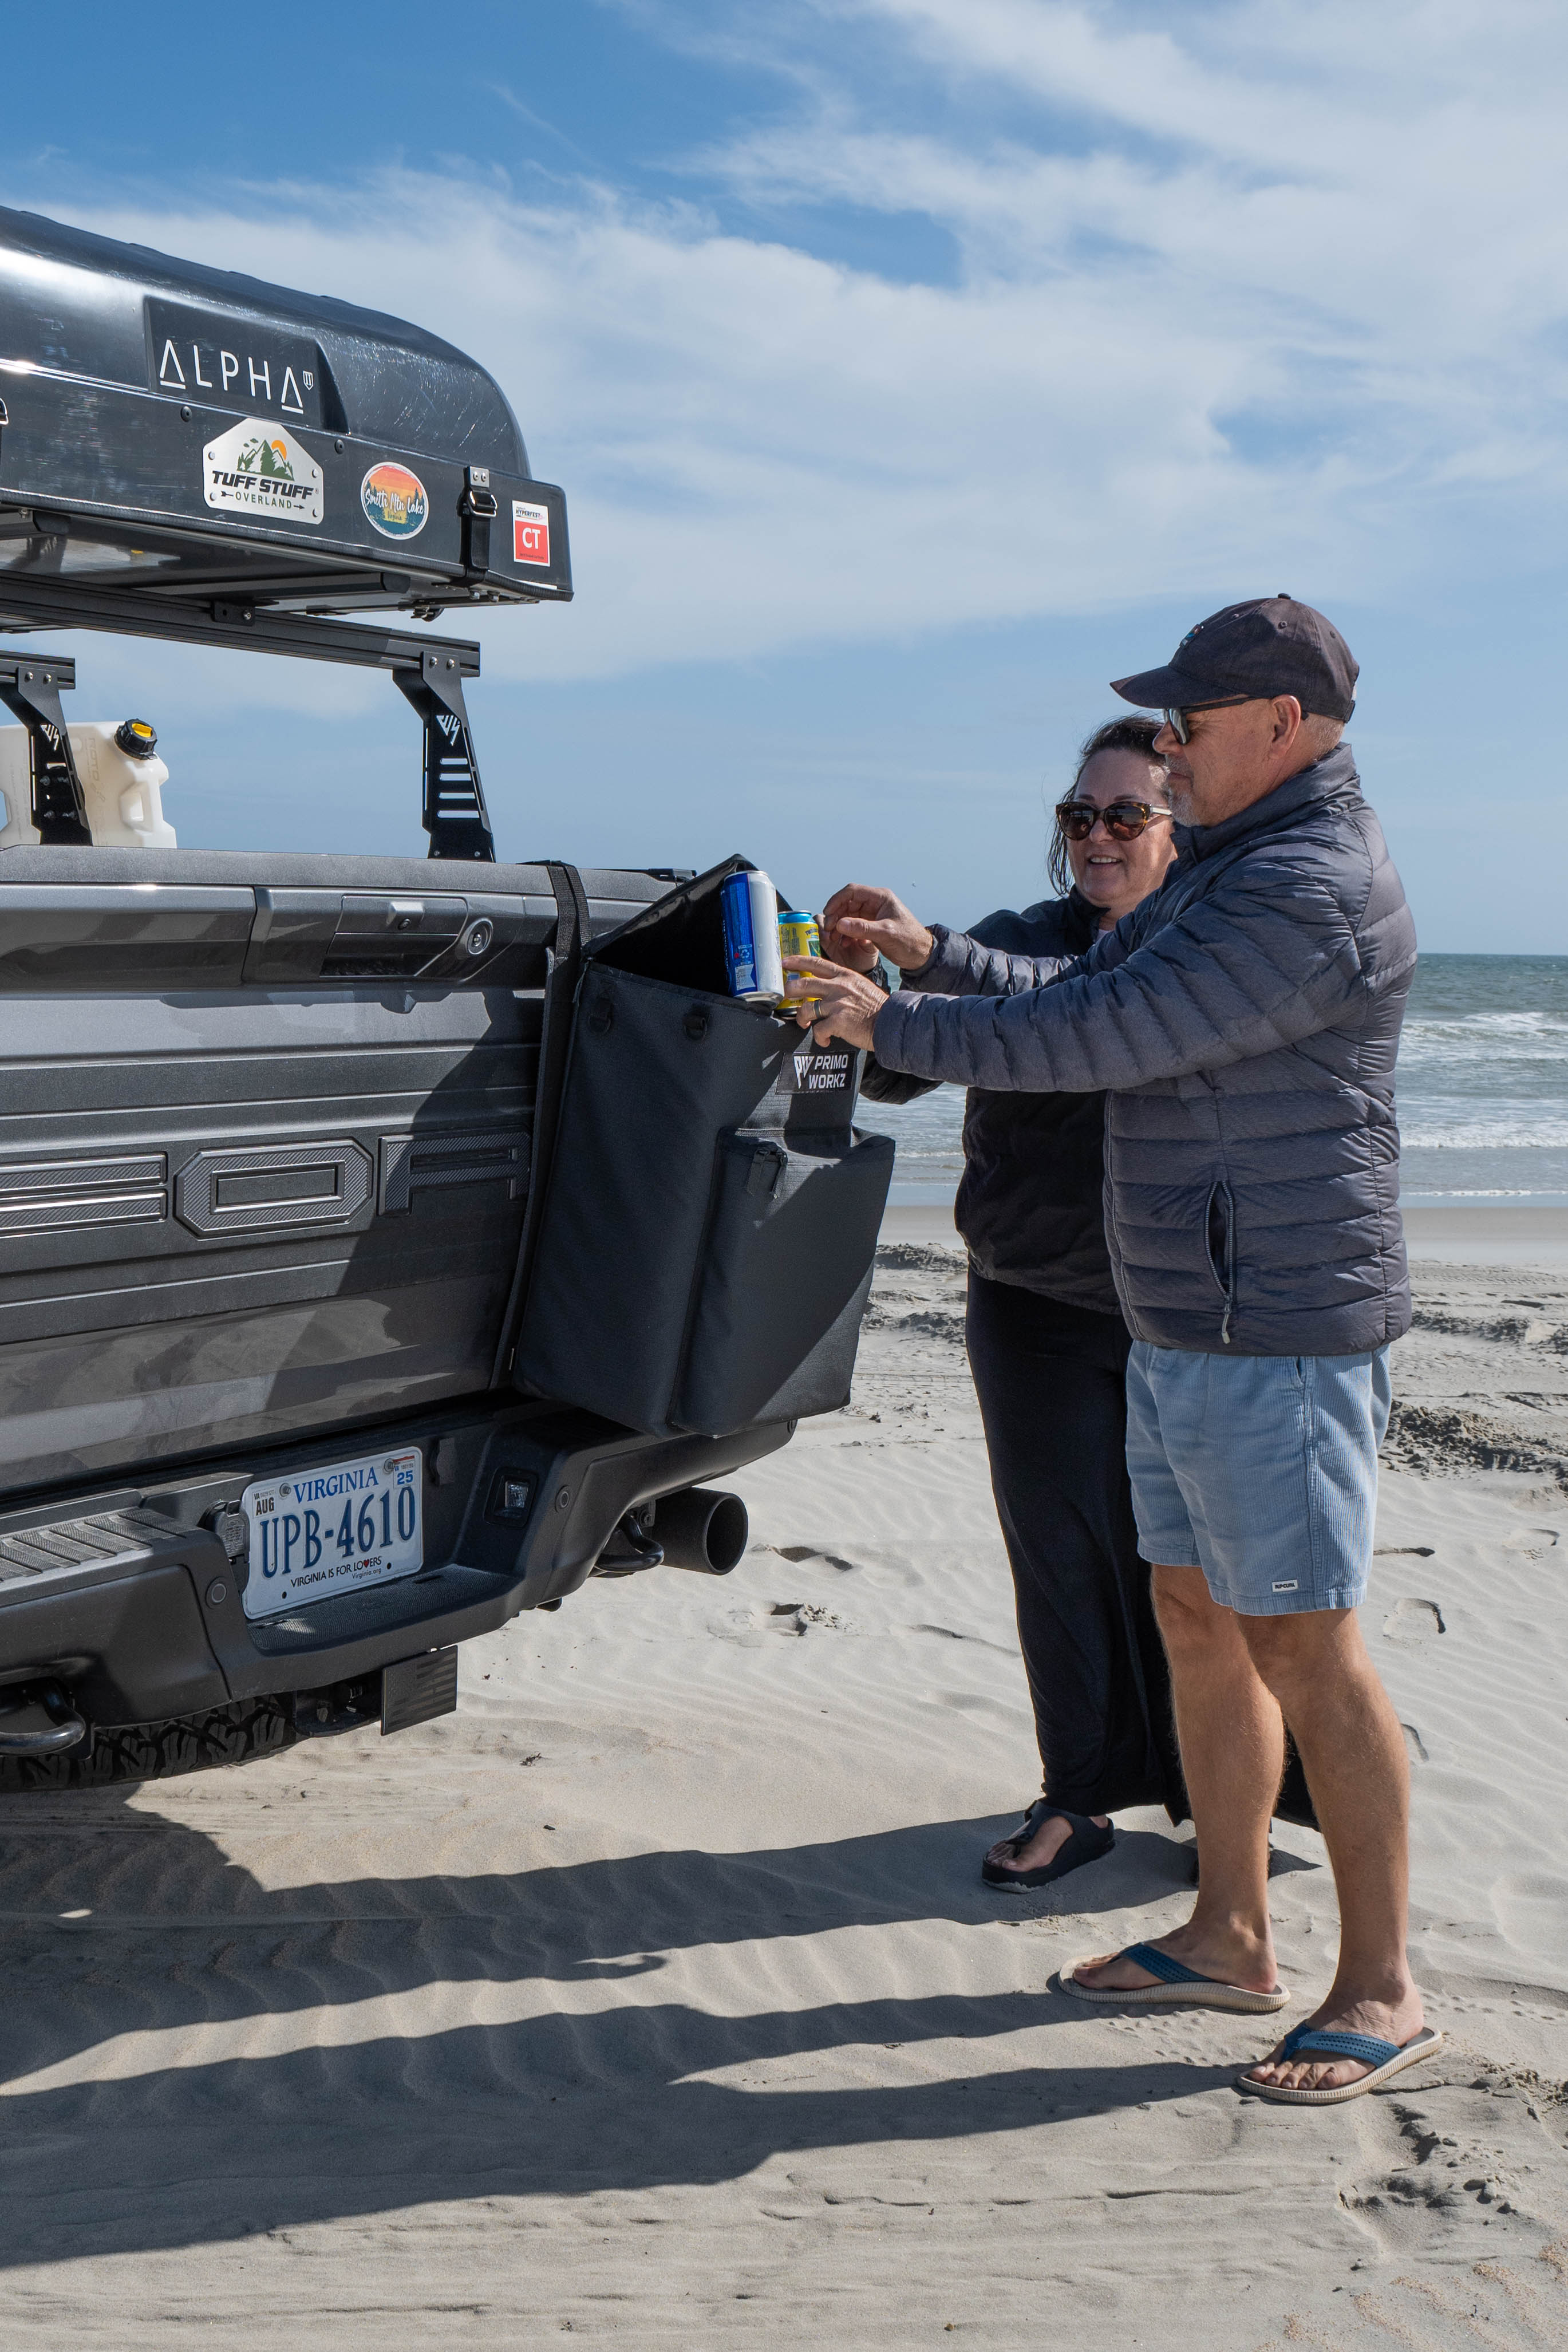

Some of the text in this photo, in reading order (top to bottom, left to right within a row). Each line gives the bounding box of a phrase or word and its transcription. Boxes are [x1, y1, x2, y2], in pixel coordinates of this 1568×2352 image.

[160, 340, 304, 414] ALPHA
[212, 471, 314, 500] TUFF STUFF
[235, 491, 292, 509] OVERLAND
[365, 488, 424, 515] Smith Mtn Lake
[522, 527, 541, 550] CT
[815, 1054, 848, 1070] PRIMO
[809, 1074, 846, 1089] WORKZ
[293, 1466, 379, 1504] VIRGINIA
[397, 1470, 413, 1485] 25
[256, 1497, 274, 1516] AUG
[259, 1486, 416, 1578] UPB-4610
[291, 1570, 326, 1588] VIRGINIA
[328, 1568, 334, 1578] IS
[336, 1564, 351, 1576] FOR
[352, 1568, 382, 1580] Virginia.org
